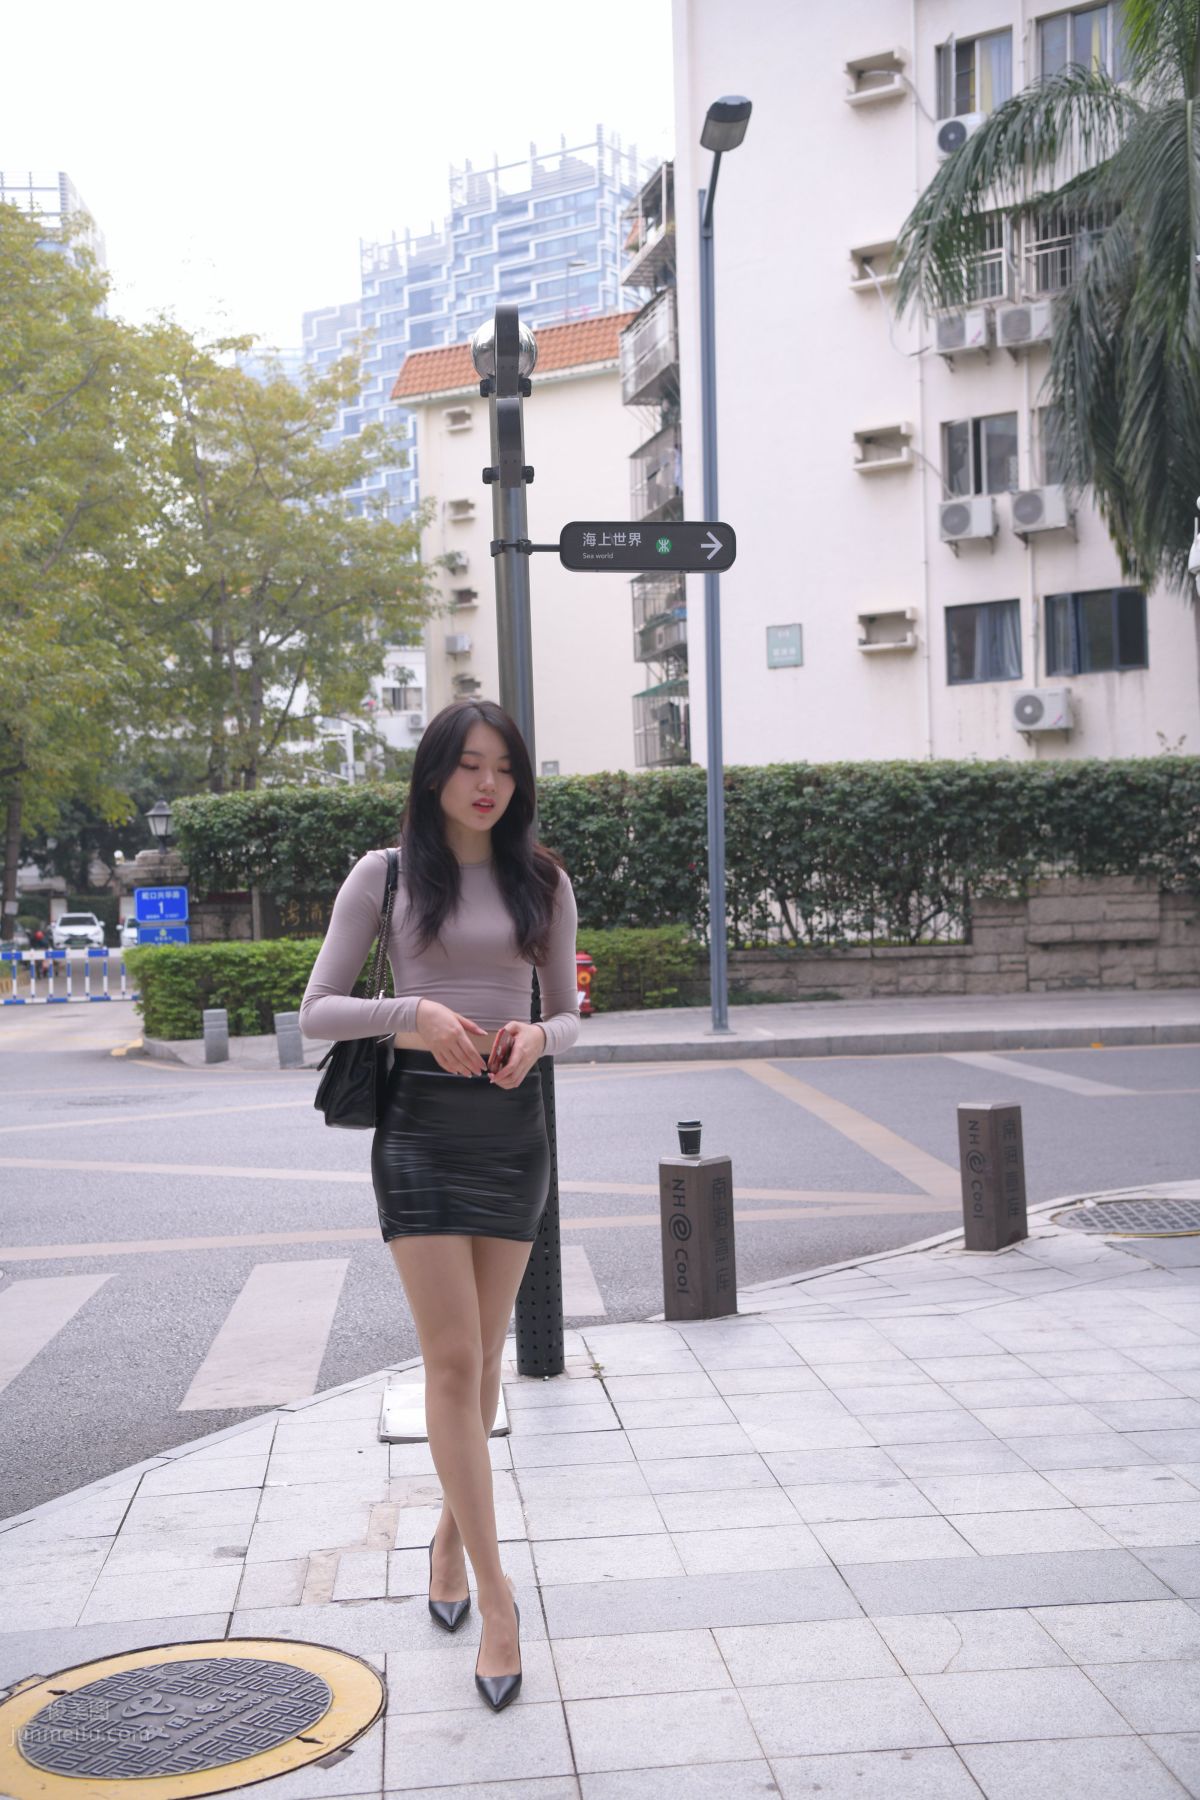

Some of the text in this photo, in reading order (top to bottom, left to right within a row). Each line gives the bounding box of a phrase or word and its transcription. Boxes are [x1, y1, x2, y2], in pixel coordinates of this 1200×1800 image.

[582, 532, 642, 547] 海上世界
[158, 901, 164, 914] 1
